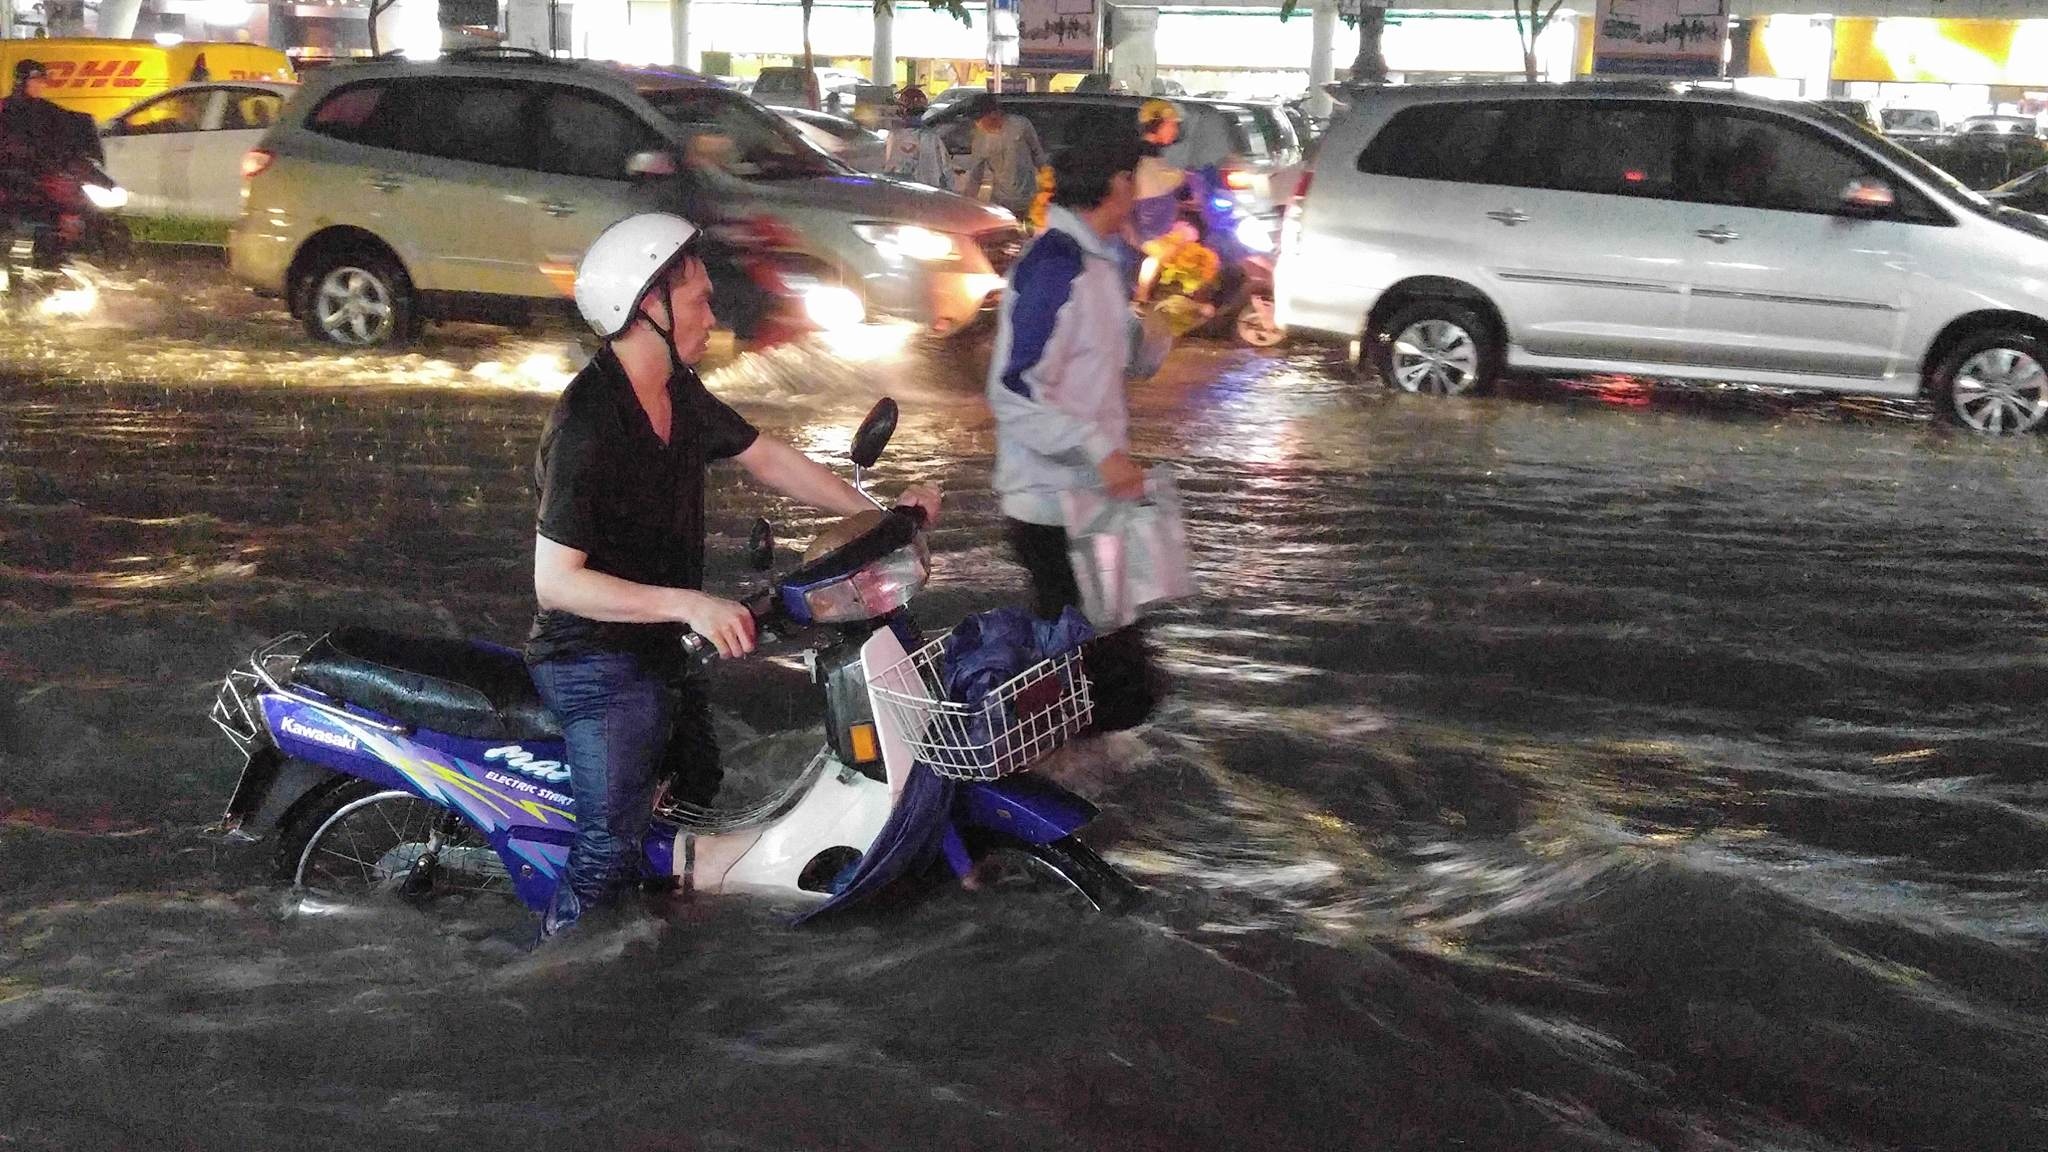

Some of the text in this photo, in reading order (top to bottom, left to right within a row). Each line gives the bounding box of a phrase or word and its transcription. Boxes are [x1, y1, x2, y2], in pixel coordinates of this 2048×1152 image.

[42, 61, 146, 88] DHL
[281, 716, 357, 750] Kawasaki
[485, 771, 576, 806] ELECTRIC START
